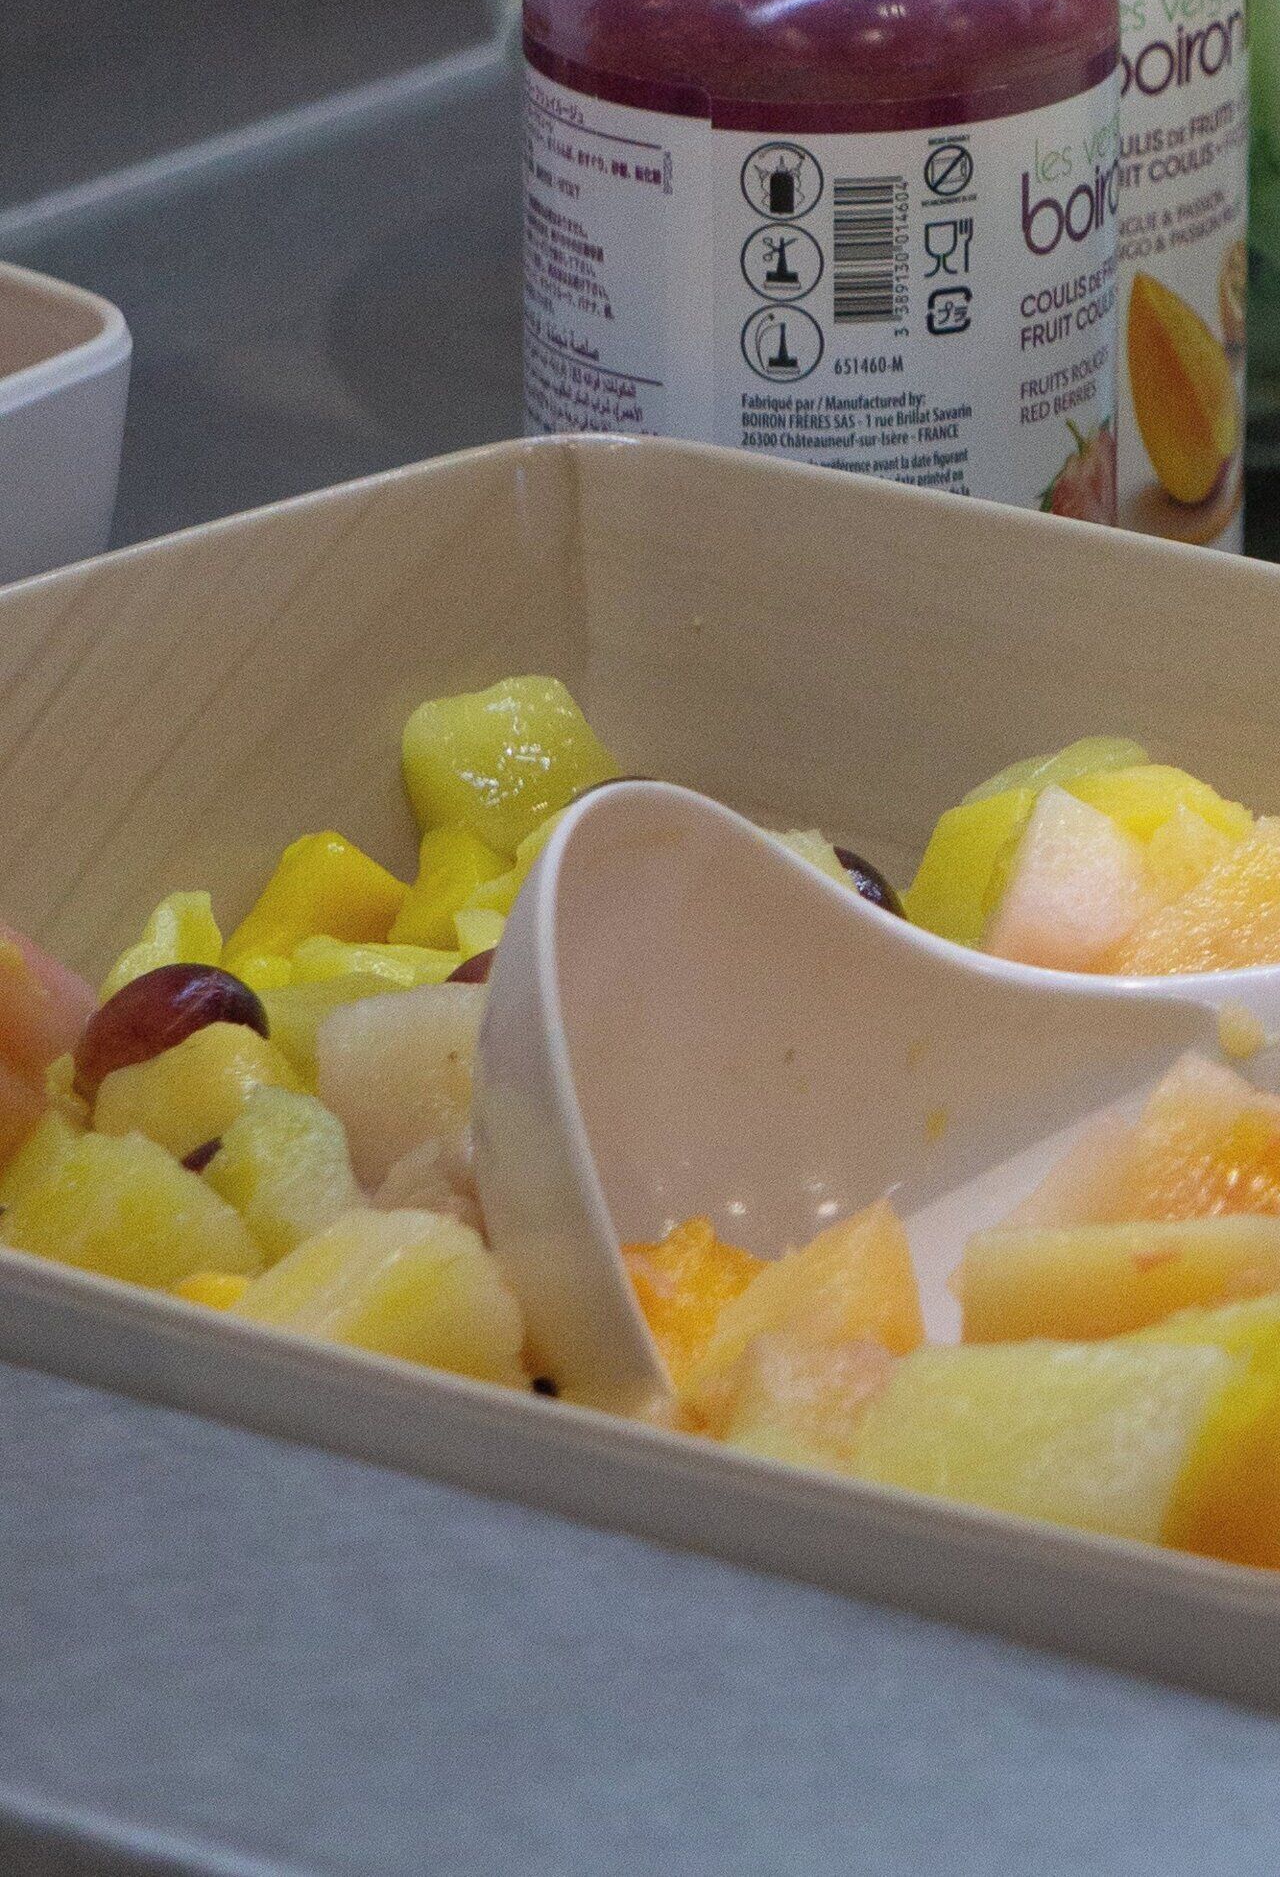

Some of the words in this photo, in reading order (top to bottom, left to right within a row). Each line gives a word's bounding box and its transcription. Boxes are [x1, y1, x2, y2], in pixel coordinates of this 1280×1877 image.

[1034, 138, 1073, 184] les
[1020, 274, 1086, 318] COULIS
[1020, 312, 1073, 352] FRUIT
[833, 355, 904, 376] 651460-M
[1020, 368, 1069, 400] FRUITS
[741, 392, 793, 413] Fabriqué
[795, 398, 815, 413] par
[824, 391, 906, 411] Manufactured
[1020, 400, 1051, 425] RED
[741, 411, 786, 427] BOIRON
[833, 413, 856, 429] SAS
[874, 414, 894, 428] rue
[932, 403, 972, 421] Savarin
[741, 430, 778, 447] 26300
[917, 423, 959, 443] FRANCE
